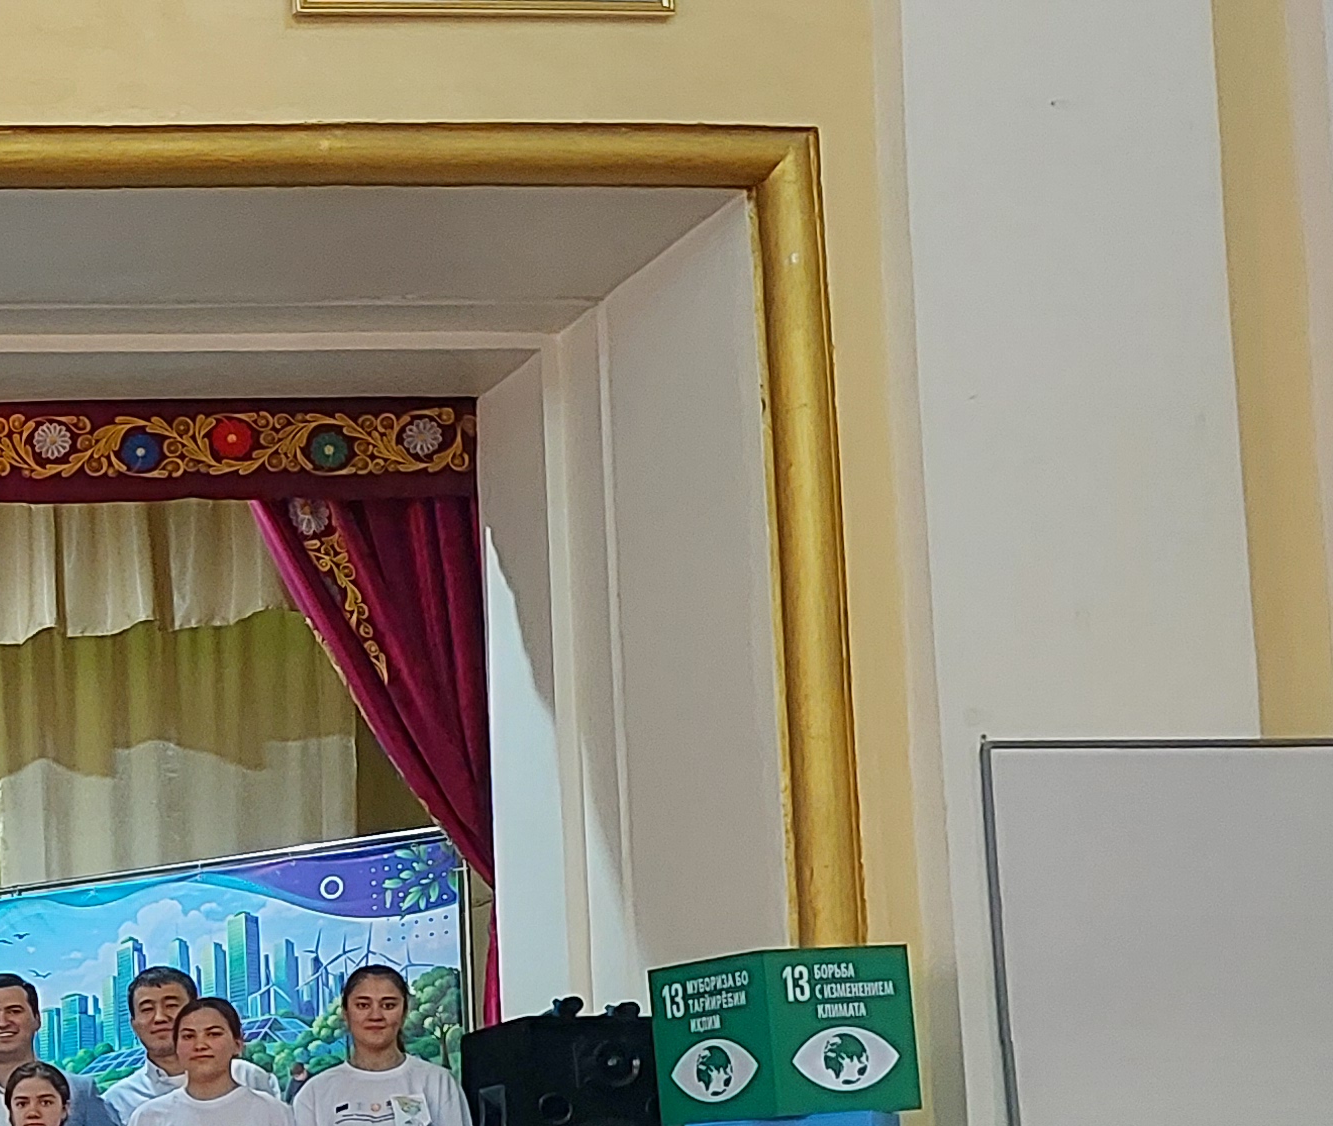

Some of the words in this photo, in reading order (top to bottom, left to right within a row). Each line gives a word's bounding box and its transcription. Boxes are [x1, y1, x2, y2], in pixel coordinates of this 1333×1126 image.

[813, 962, 855, 980] БОРЬБА
[782, 965, 811, 1003] 13
[824, 979, 895, 999] ИЗМЕНЕНИЕМ
[662, 982, 685, 1019] 13
[817, 1001, 867, 1019] КЛИМАТА
